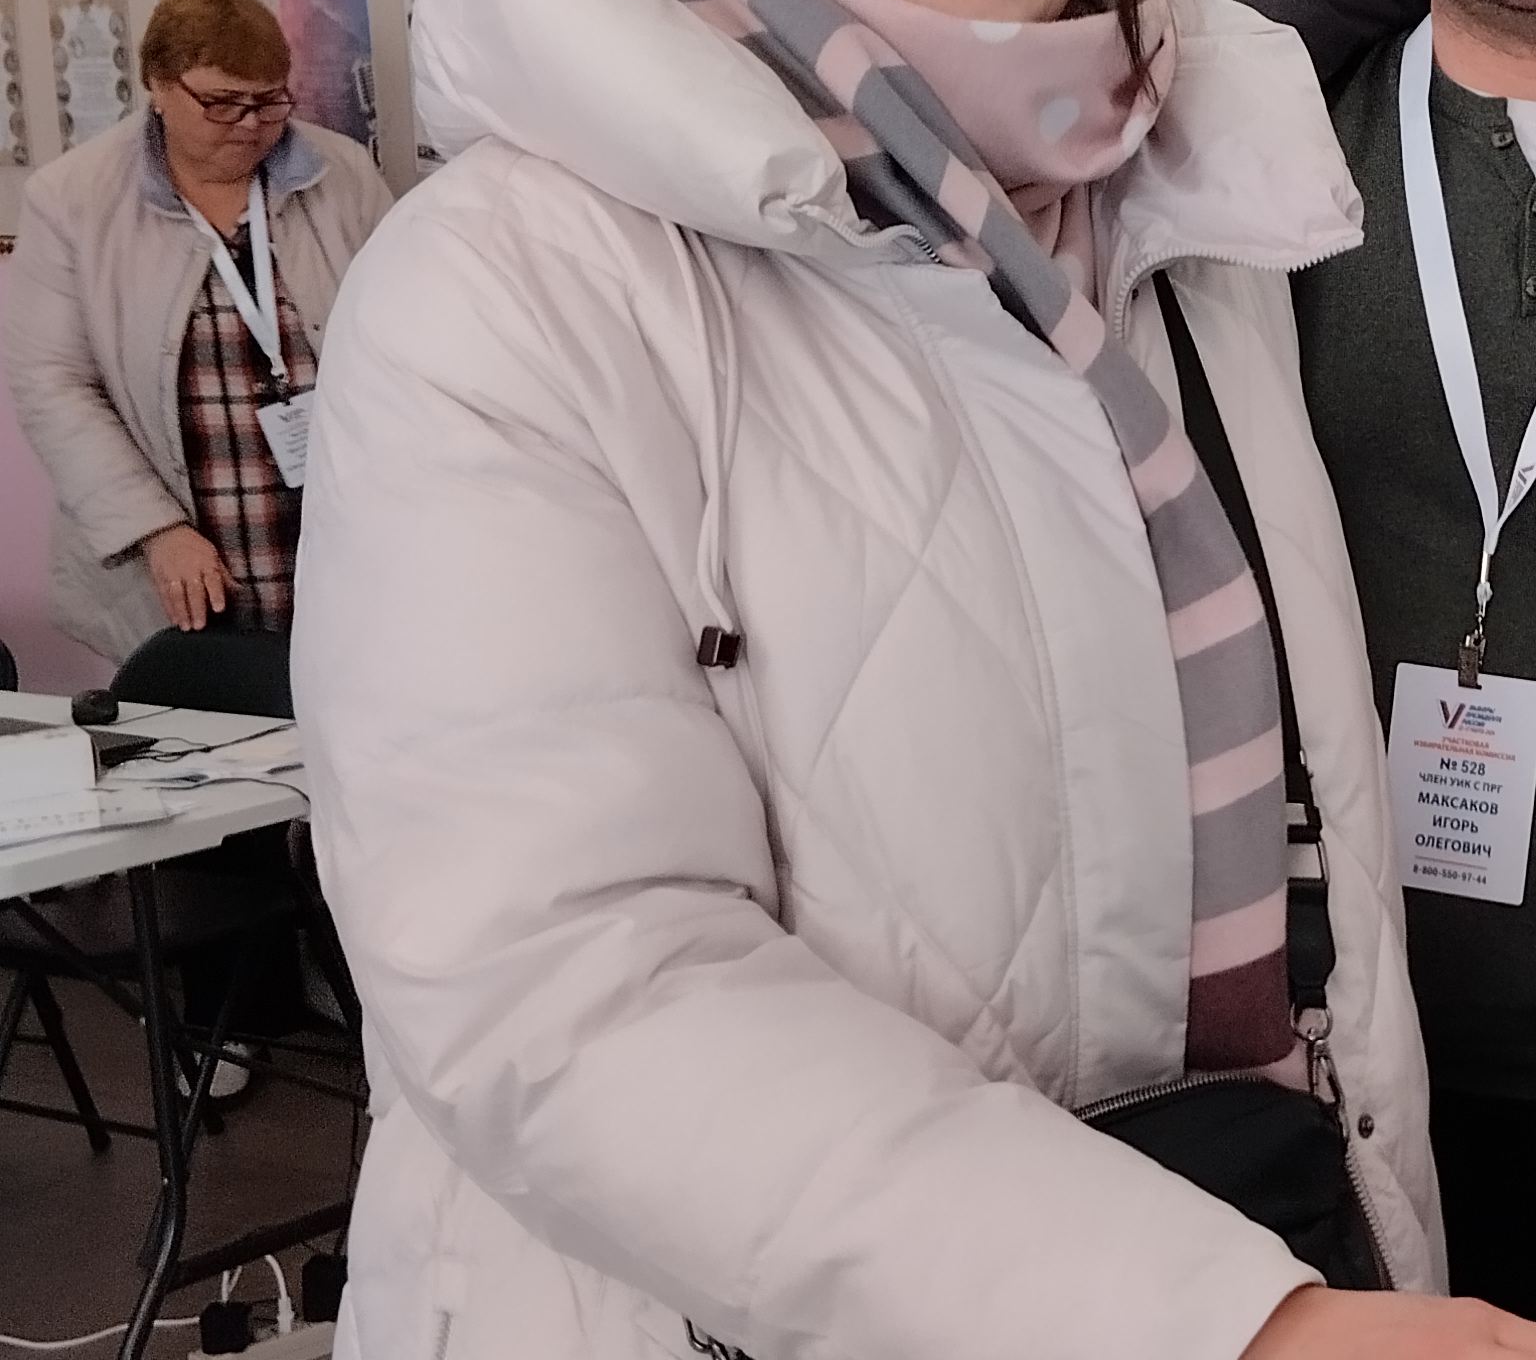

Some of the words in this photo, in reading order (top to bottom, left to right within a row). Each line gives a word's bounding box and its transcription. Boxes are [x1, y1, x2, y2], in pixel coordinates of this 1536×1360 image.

[1461, 759, 1486, 776] 528
[1418, 772, 1447, 786] ЧЛЕН
[1449, 776, 1471, 789] УИК
[1417, 791, 1499, 816] МАКСАКОВ
[1432, 814, 1479, 834] ИГОРЬ
[1415, 833, 1492, 858] ОЛЕГОВИЧ
